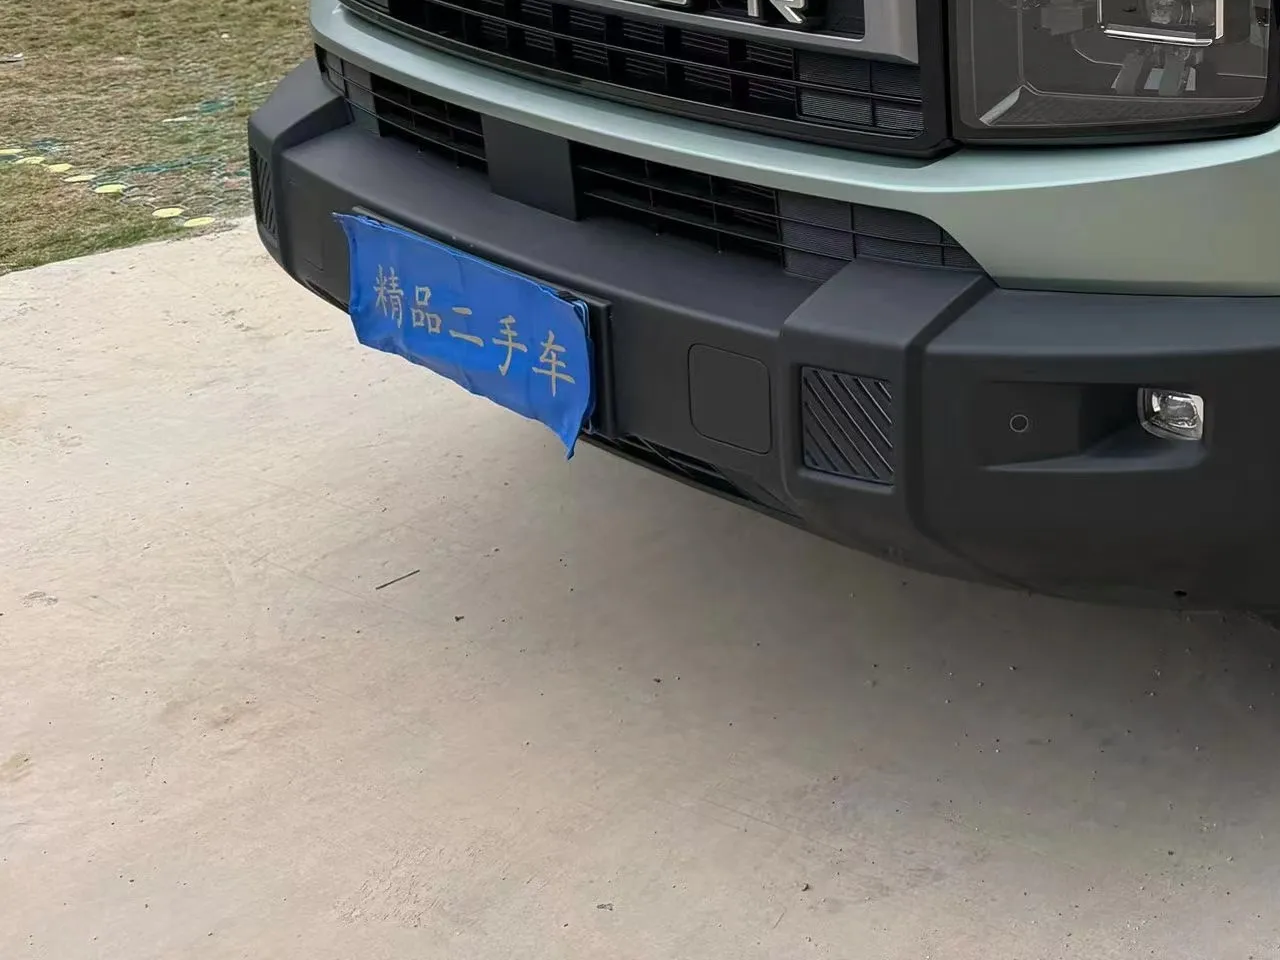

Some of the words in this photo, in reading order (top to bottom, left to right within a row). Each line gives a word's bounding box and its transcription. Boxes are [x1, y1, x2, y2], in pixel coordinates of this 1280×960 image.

[373, 264, 576, 397] 精品二手车
